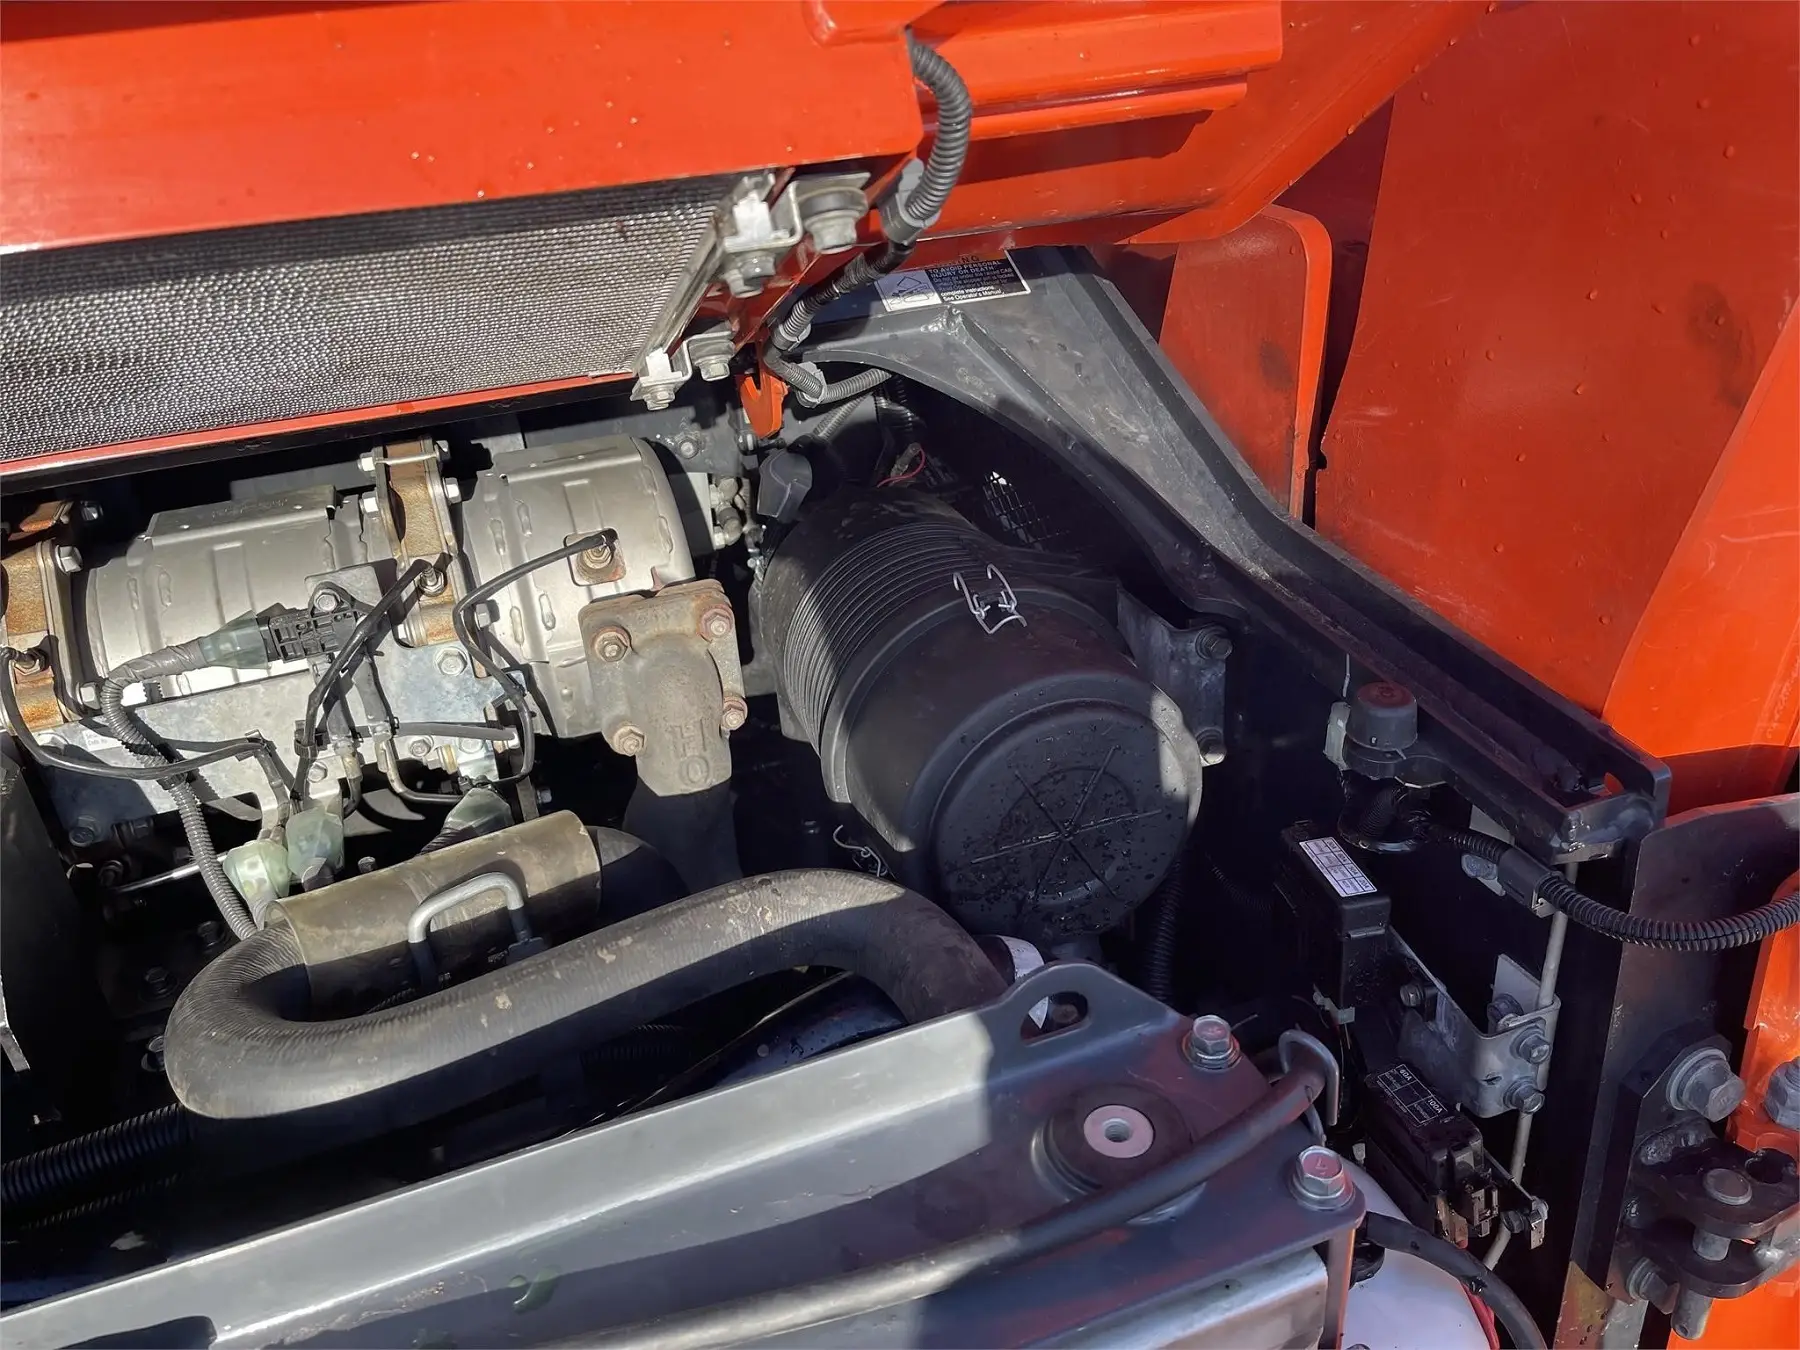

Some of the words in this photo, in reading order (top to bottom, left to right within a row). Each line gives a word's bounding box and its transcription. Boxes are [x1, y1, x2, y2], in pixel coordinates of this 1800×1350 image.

[940, 265, 963, 273] AVOID
[963, 260, 1001, 270] PERSONAL
[930, 270, 956, 279] INJURY
[940, 289, 965, 297] complete
[954, 291, 983, 300] Operator's
[1427, 1098, 1443, 1114] 100A
